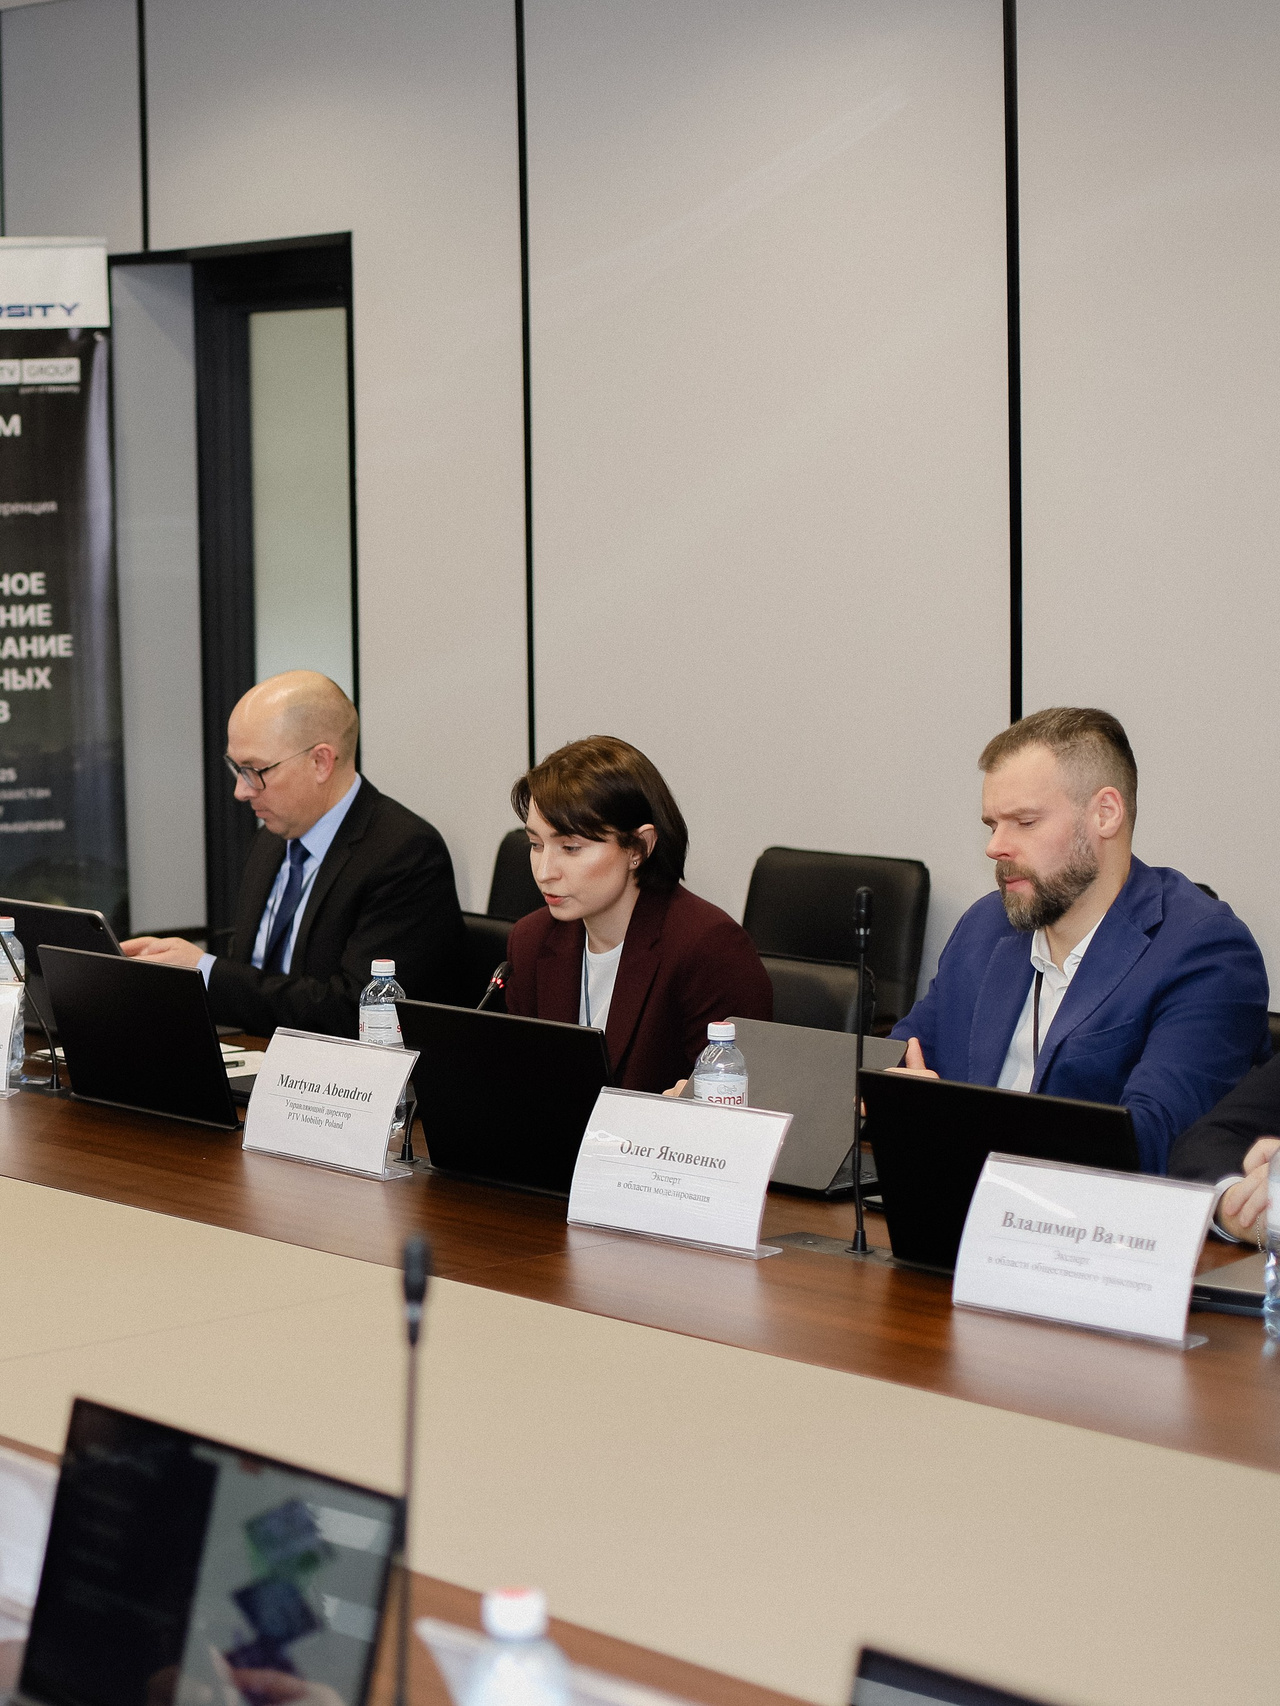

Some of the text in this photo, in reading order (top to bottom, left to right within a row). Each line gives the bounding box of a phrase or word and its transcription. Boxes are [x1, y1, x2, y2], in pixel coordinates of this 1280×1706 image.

[277, 1074, 373, 1103] Martyna Abendrot
[707, 1091, 745, 1105] samal
[285, 1099, 352, 1121] Управляющий директор
[287, 1111, 344, 1129] PTV Mobility Poland
[620, 1139, 726, 1170] Олег Яковенко
[651, 1171, 682, 1185] Эксперт
[623, 1180, 652, 1193] области
[653, 1186, 711, 1203] моделирования
[1001, 1211, 1087, 1244] Владимир
[995, 1256, 1029, 1270] области
